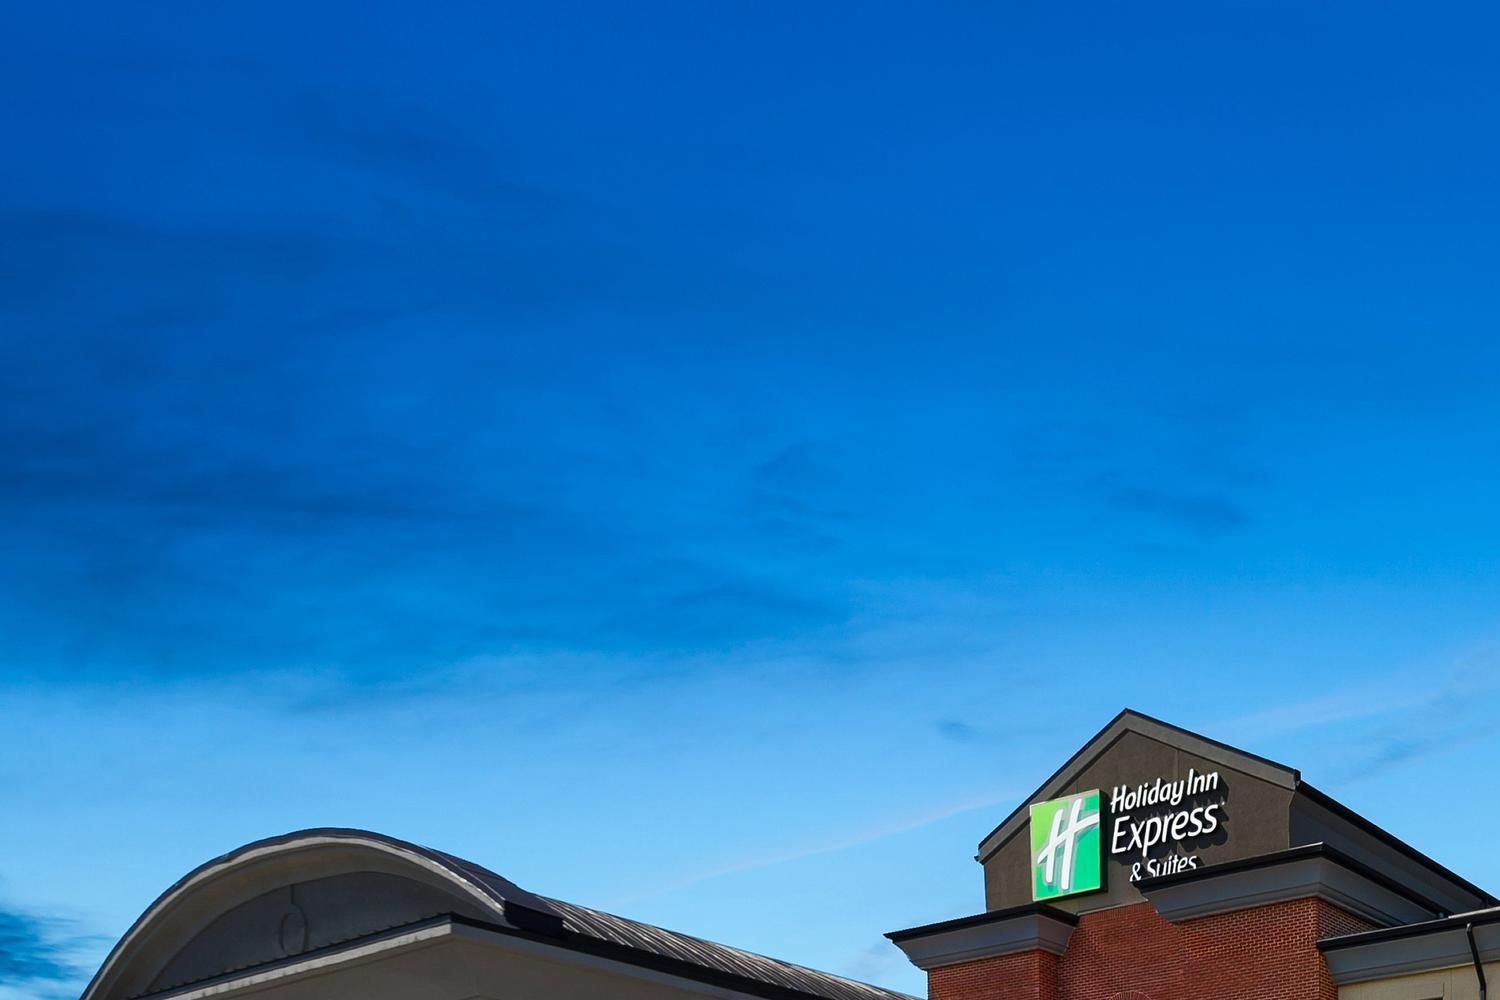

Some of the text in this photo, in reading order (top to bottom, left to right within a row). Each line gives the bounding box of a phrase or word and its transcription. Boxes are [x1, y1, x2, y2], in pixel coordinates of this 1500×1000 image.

[1110, 768, 1218, 814] Holiday Inn
[1112, 803, 1219, 857] Express
[1129, 854, 1197, 882] & Suites
